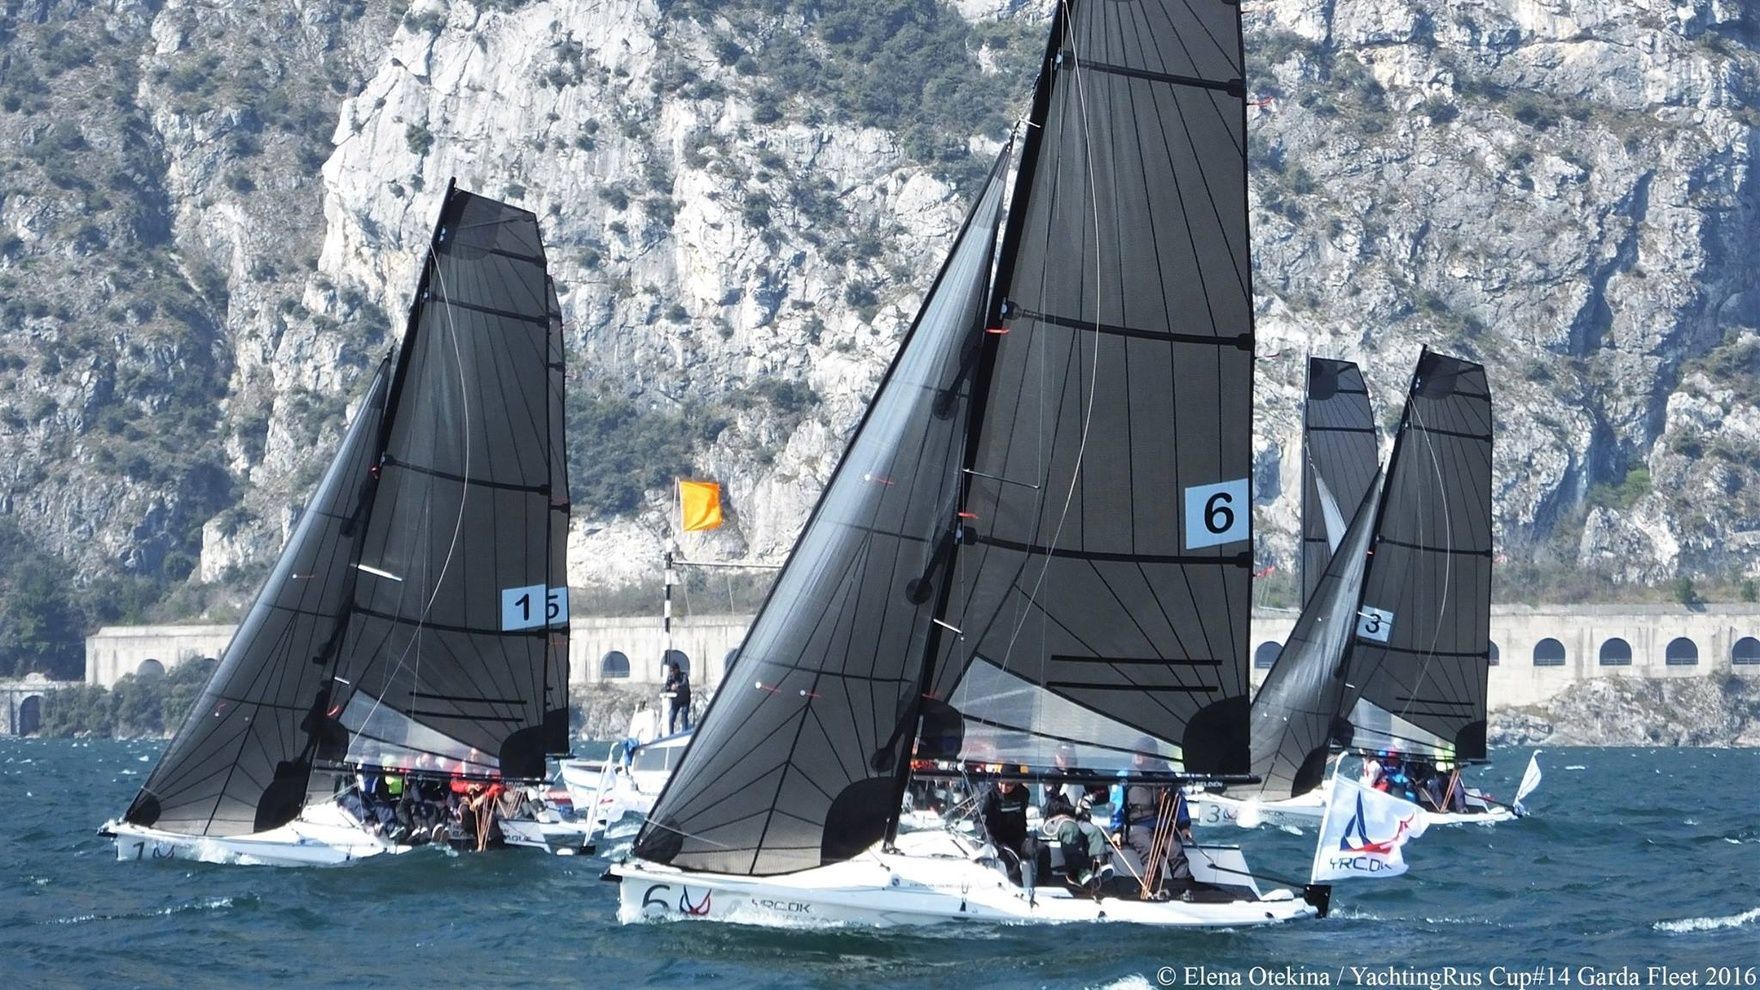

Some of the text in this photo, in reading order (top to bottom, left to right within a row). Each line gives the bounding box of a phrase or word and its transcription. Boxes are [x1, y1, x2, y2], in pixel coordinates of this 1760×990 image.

[1204, 492, 1234, 534] 6
[515, 593, 529, 621] 1
[1365, 613, 1382, 634] 3
[1206, 804, 1220, 823] 3
[641, 883, 671, 914] 6
